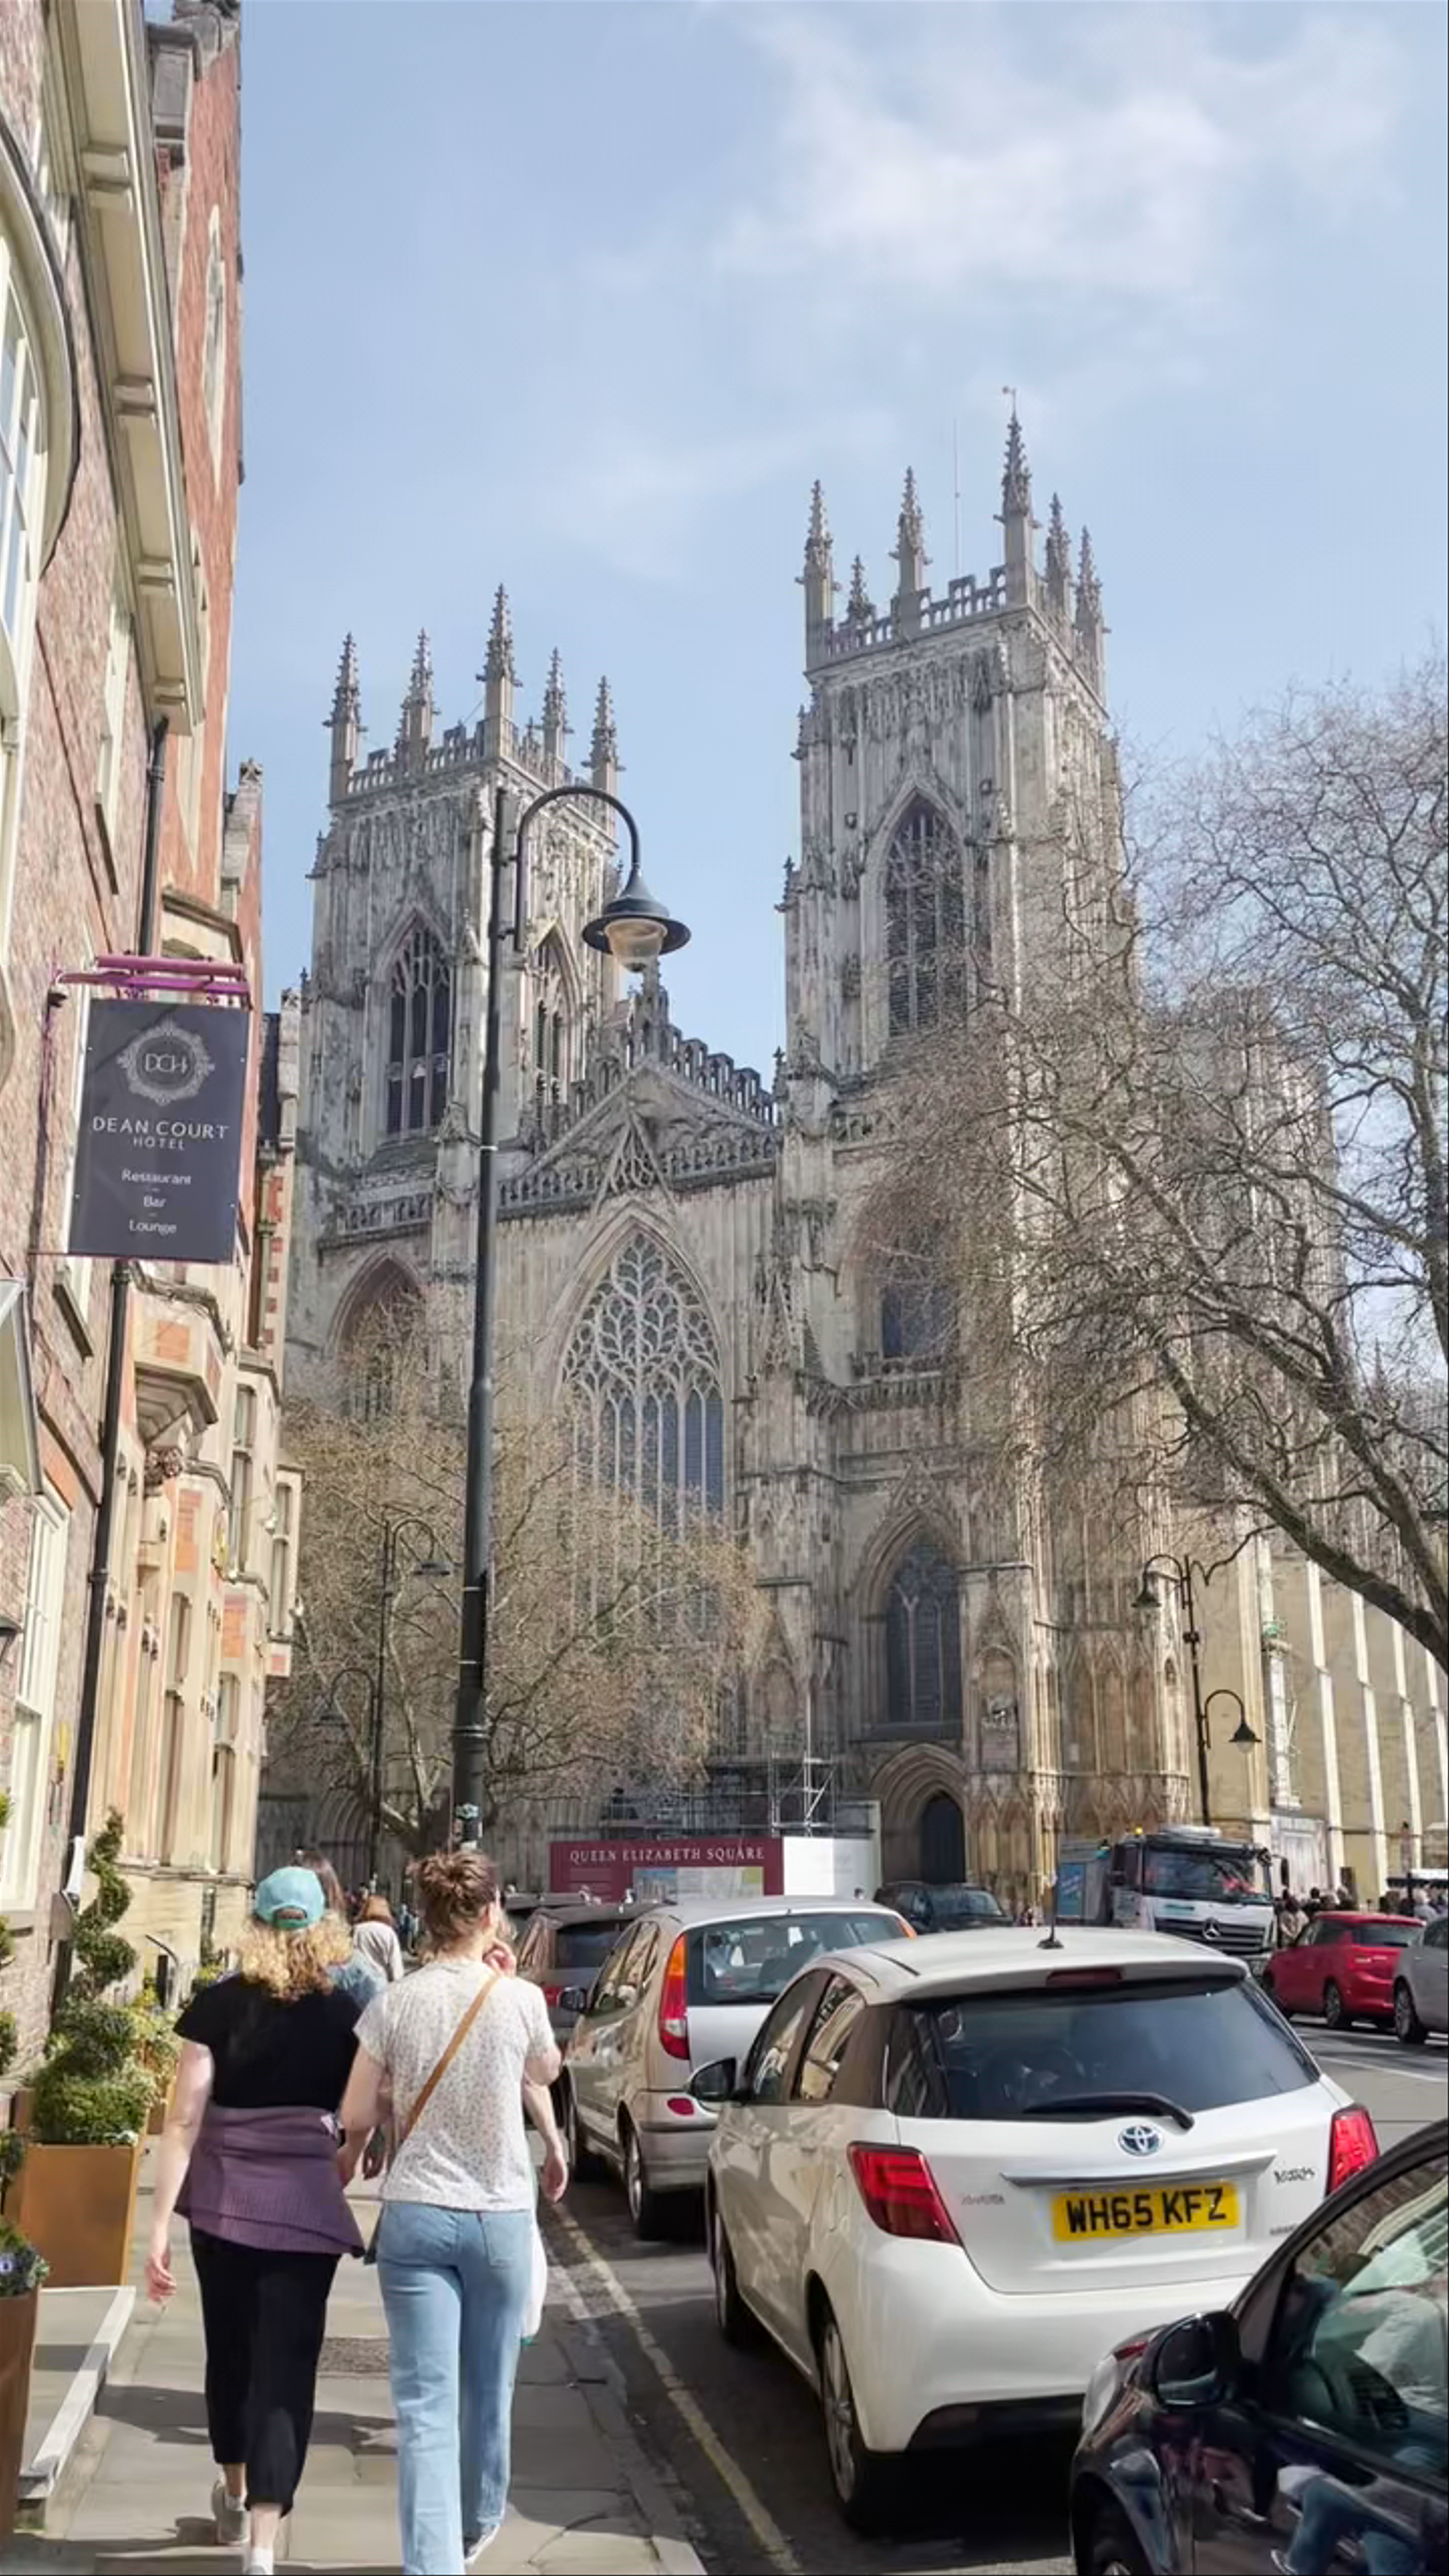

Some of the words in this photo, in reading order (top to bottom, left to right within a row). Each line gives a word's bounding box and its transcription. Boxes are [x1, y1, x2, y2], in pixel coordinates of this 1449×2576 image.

[93, 1116, 149, 1134] DEAN
[156, 1120, 229, 1139] COURT
[133, 1136, 185, 1150] HOTEL
[122, 1169, 191, 1185] Restaurant
[144, 1195, 167, 1207] Bar
[129, 1219, 177, 1236] Lounge
[570, 1850, 616, 1865] QUEEN
[623, 1849, 701, 1862] ELIZABETH
[706, 1847, 764, 1863] SQUARE
[1067, 2194, 1153, 2233] WH65
[1162, 2187, 1226, 2225] KFZ
